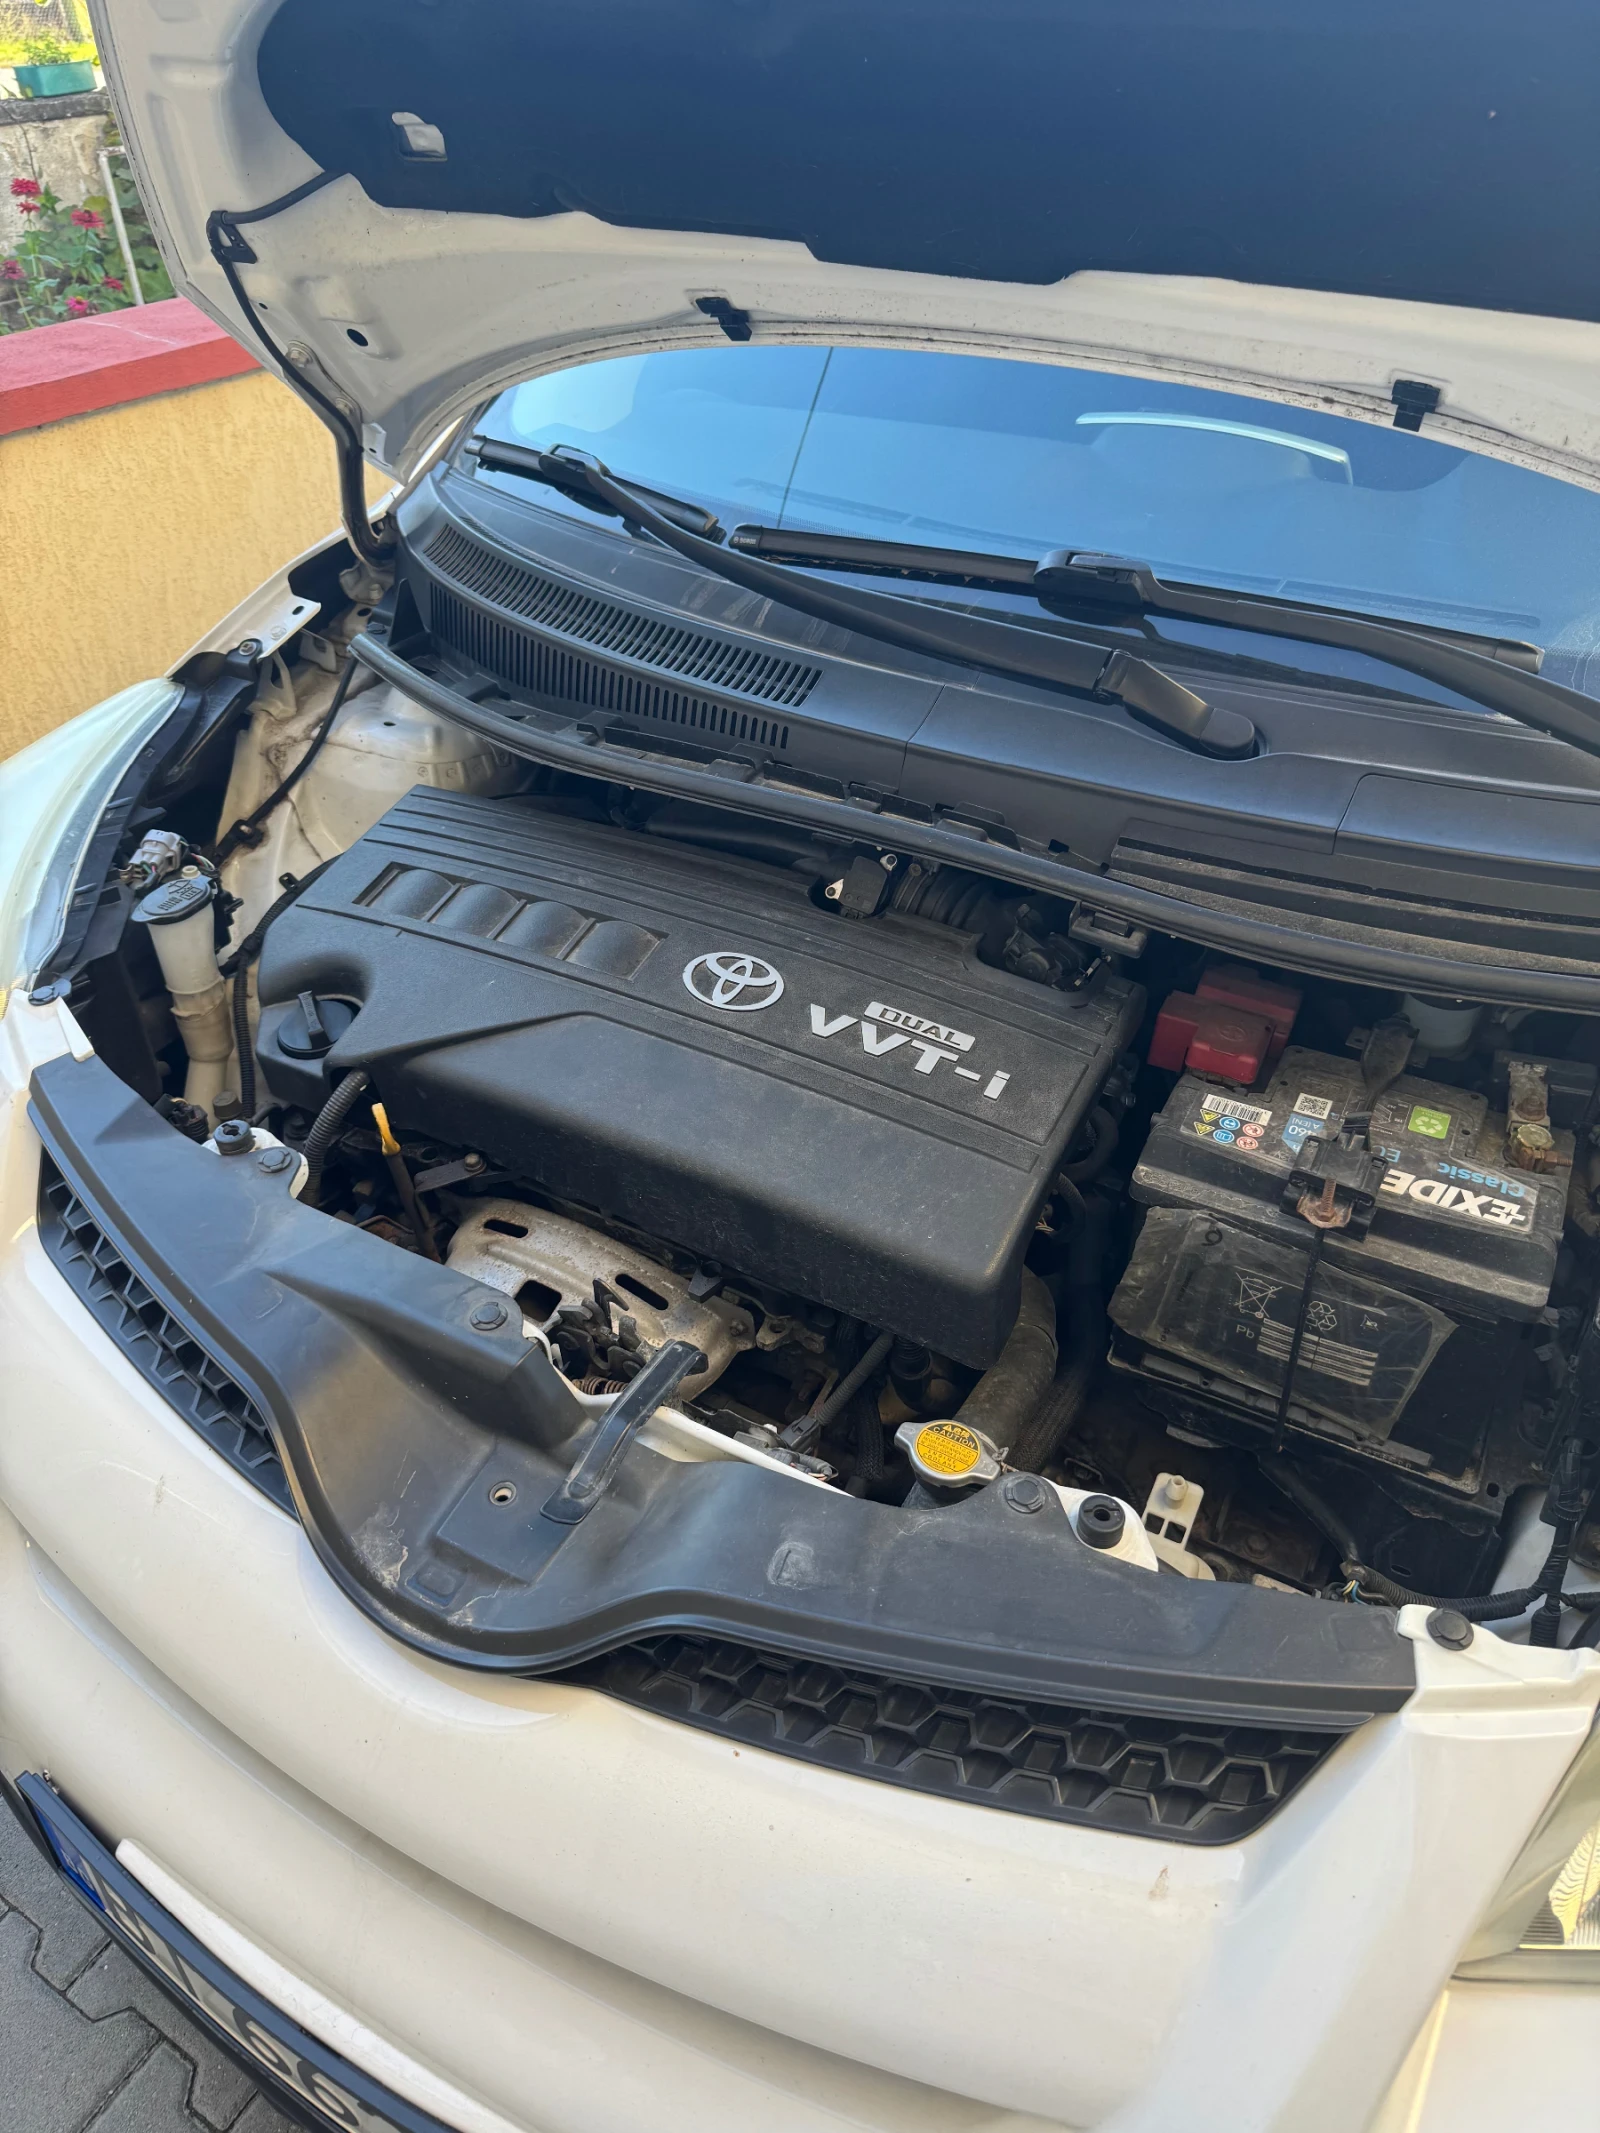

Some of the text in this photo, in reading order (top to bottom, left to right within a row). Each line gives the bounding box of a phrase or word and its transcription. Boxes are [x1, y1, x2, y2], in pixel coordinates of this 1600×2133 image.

[879, 1007, 963, 1047] DUAL
[810, 1003, 1011, 1101] VVT-i
[1379, 1168, 1527, 1225] EXIDE
[1436, 1162, 1526, 1198] Classic
[1235, 1324, 1255, 1340] Pb
[933, 1426, 976, 1449] CAUTION
